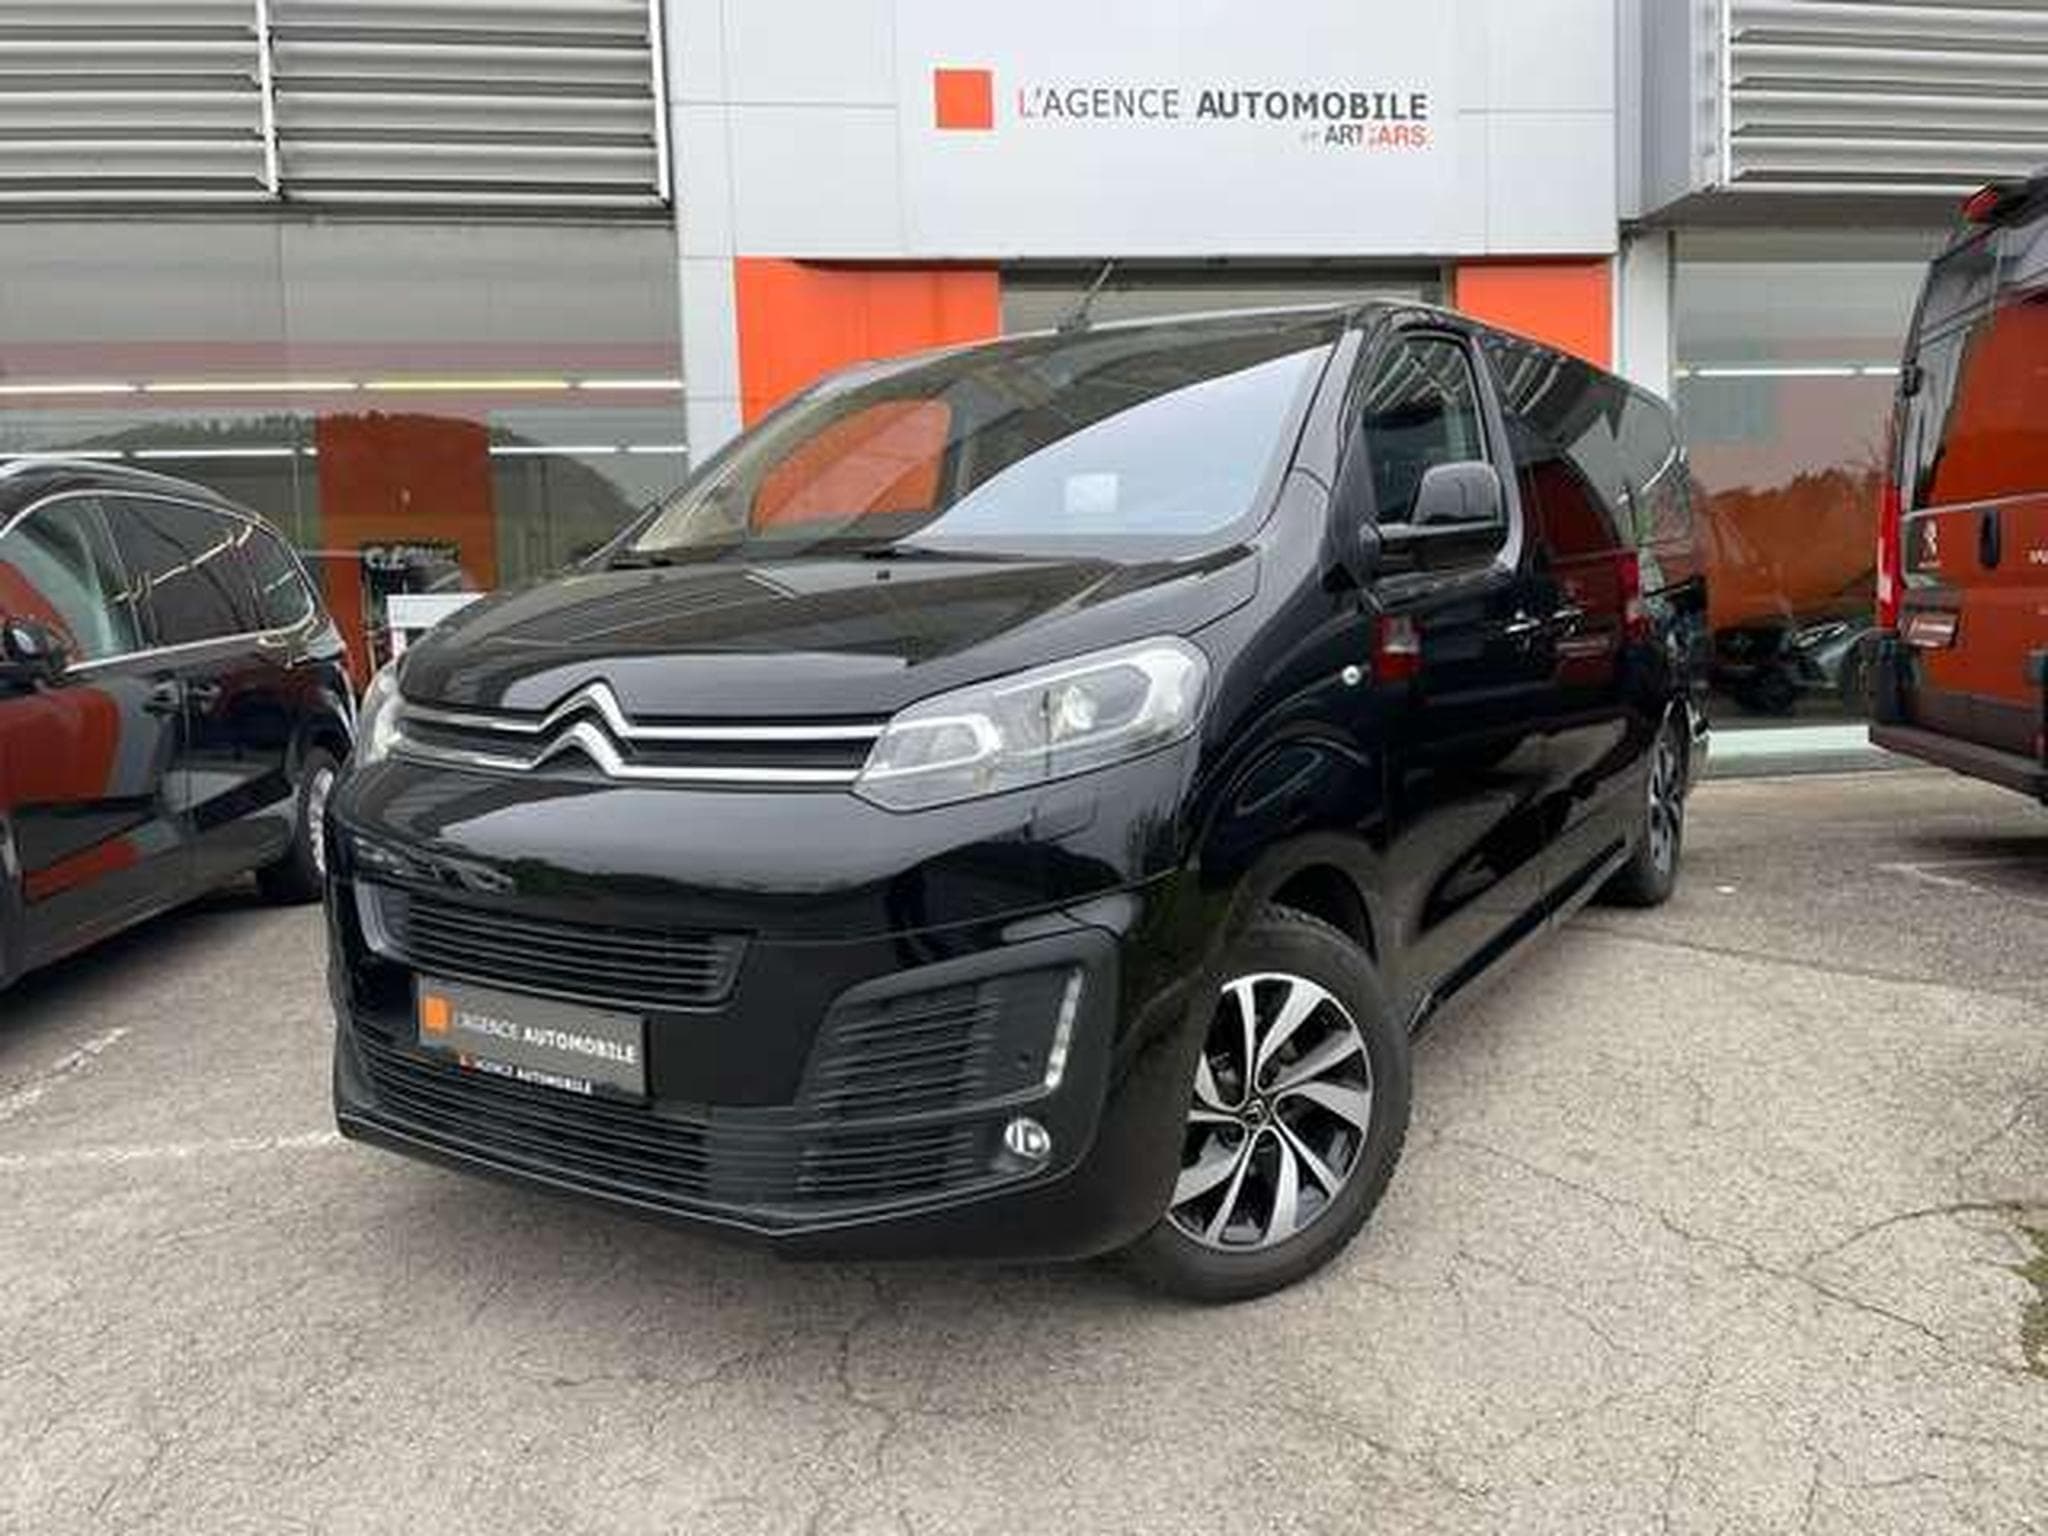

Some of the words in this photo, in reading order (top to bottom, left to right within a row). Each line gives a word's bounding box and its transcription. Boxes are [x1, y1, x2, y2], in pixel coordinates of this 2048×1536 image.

[1018, 88, 1180, 119] L'AGENCE
[1196, 90, 1428, 120] AUTOMOBILE
[523, 1026, 636, 1065] AUTOMOBILE
